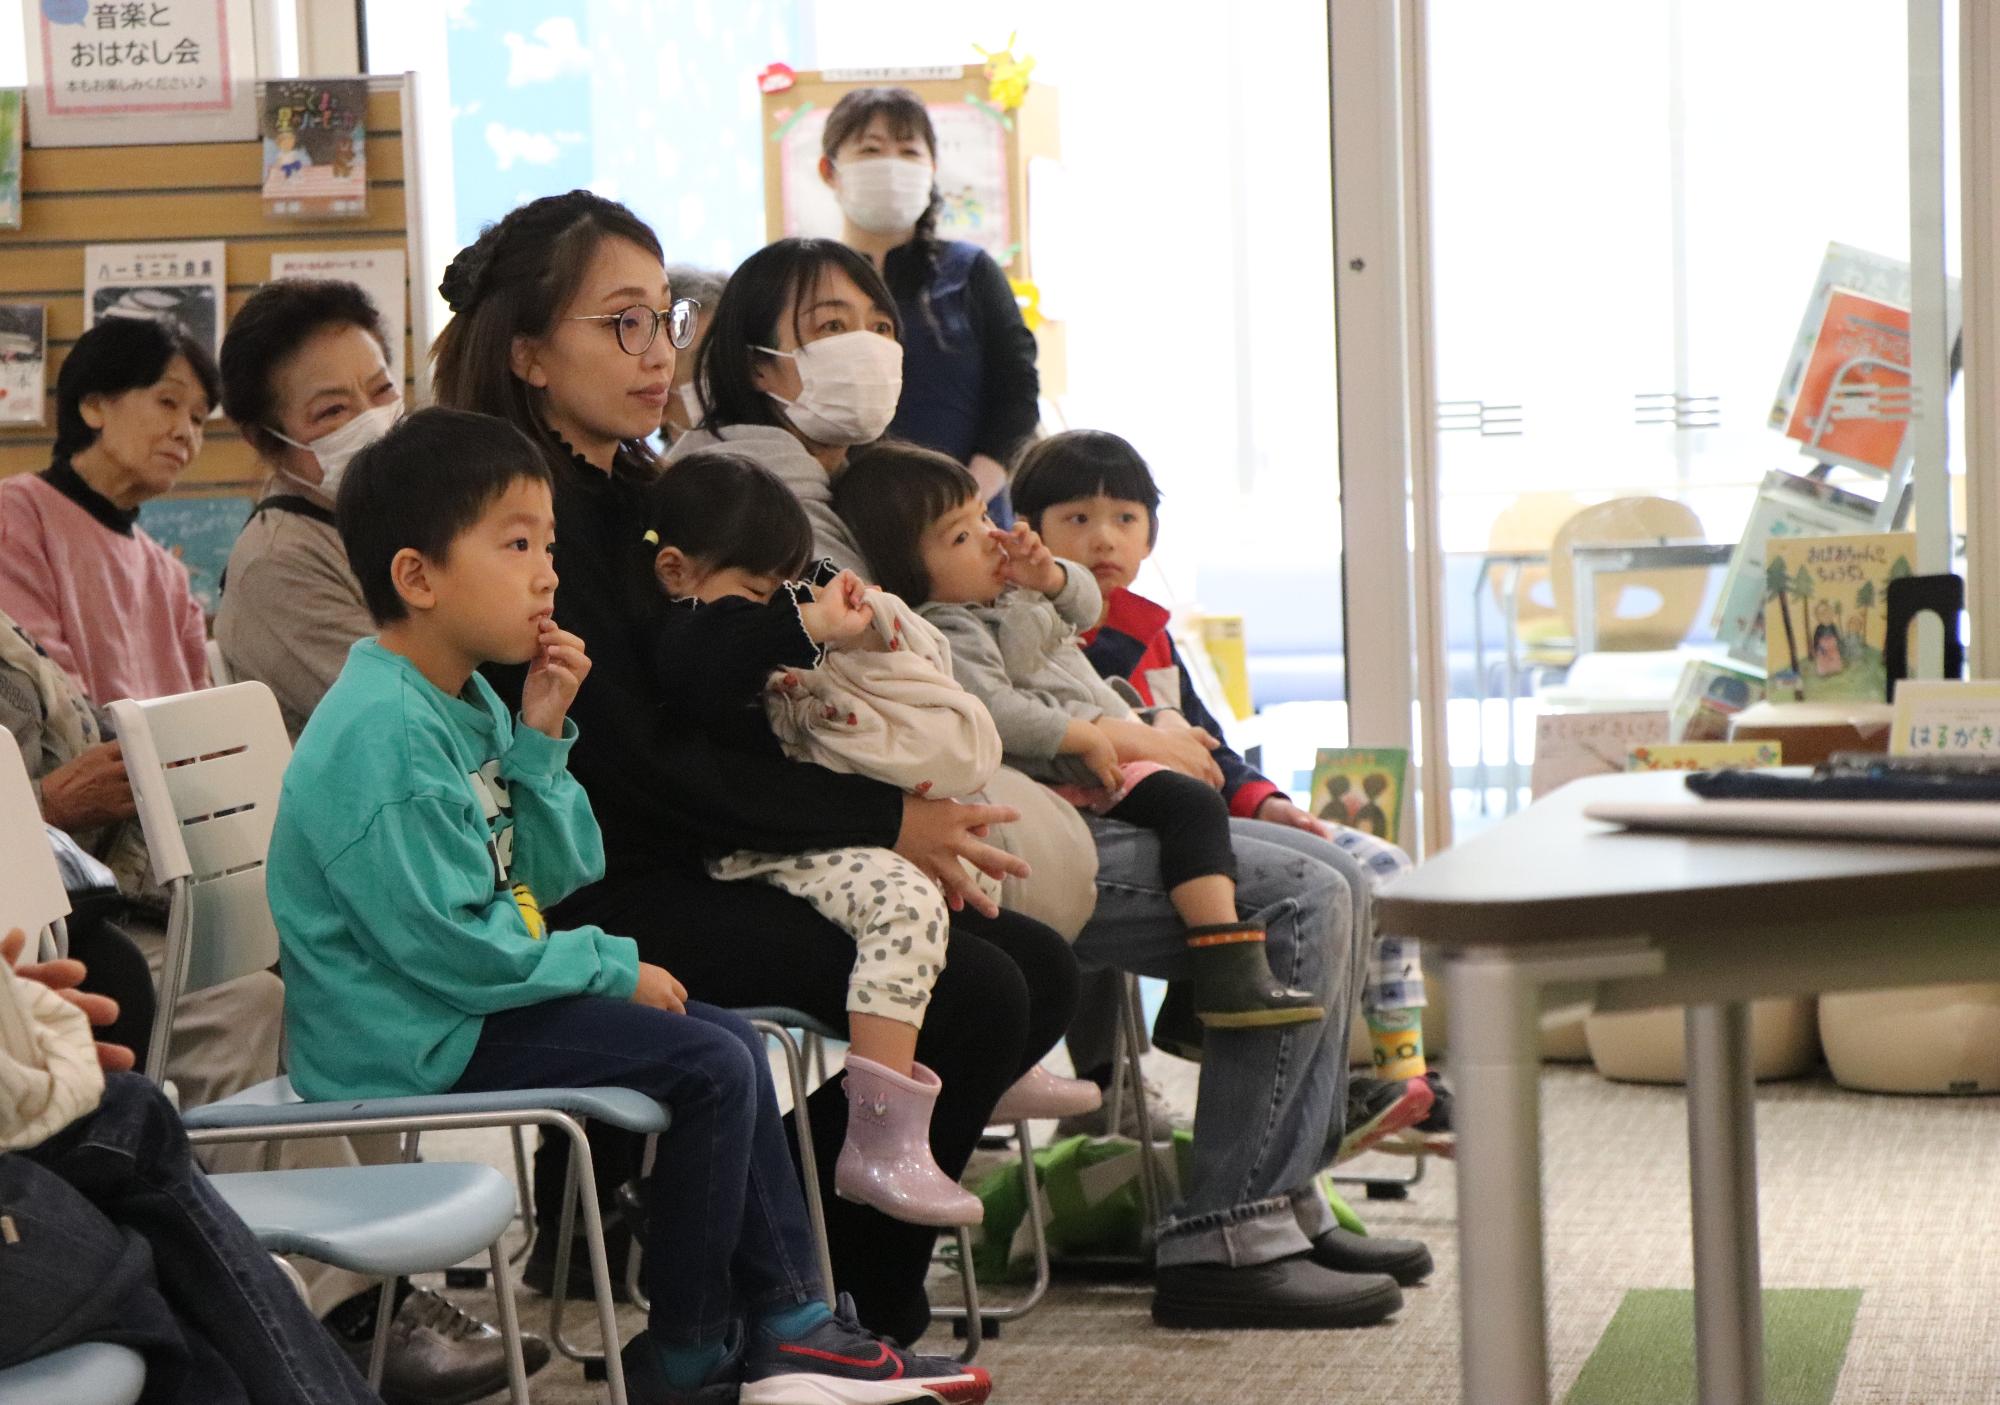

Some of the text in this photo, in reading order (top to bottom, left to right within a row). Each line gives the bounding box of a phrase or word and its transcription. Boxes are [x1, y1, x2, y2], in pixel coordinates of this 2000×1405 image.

[92, 2, 171, 30] 音楽と
[71, 37, 200, 67] おはなし会
[1910, 724, 2000, 750] はるがき
